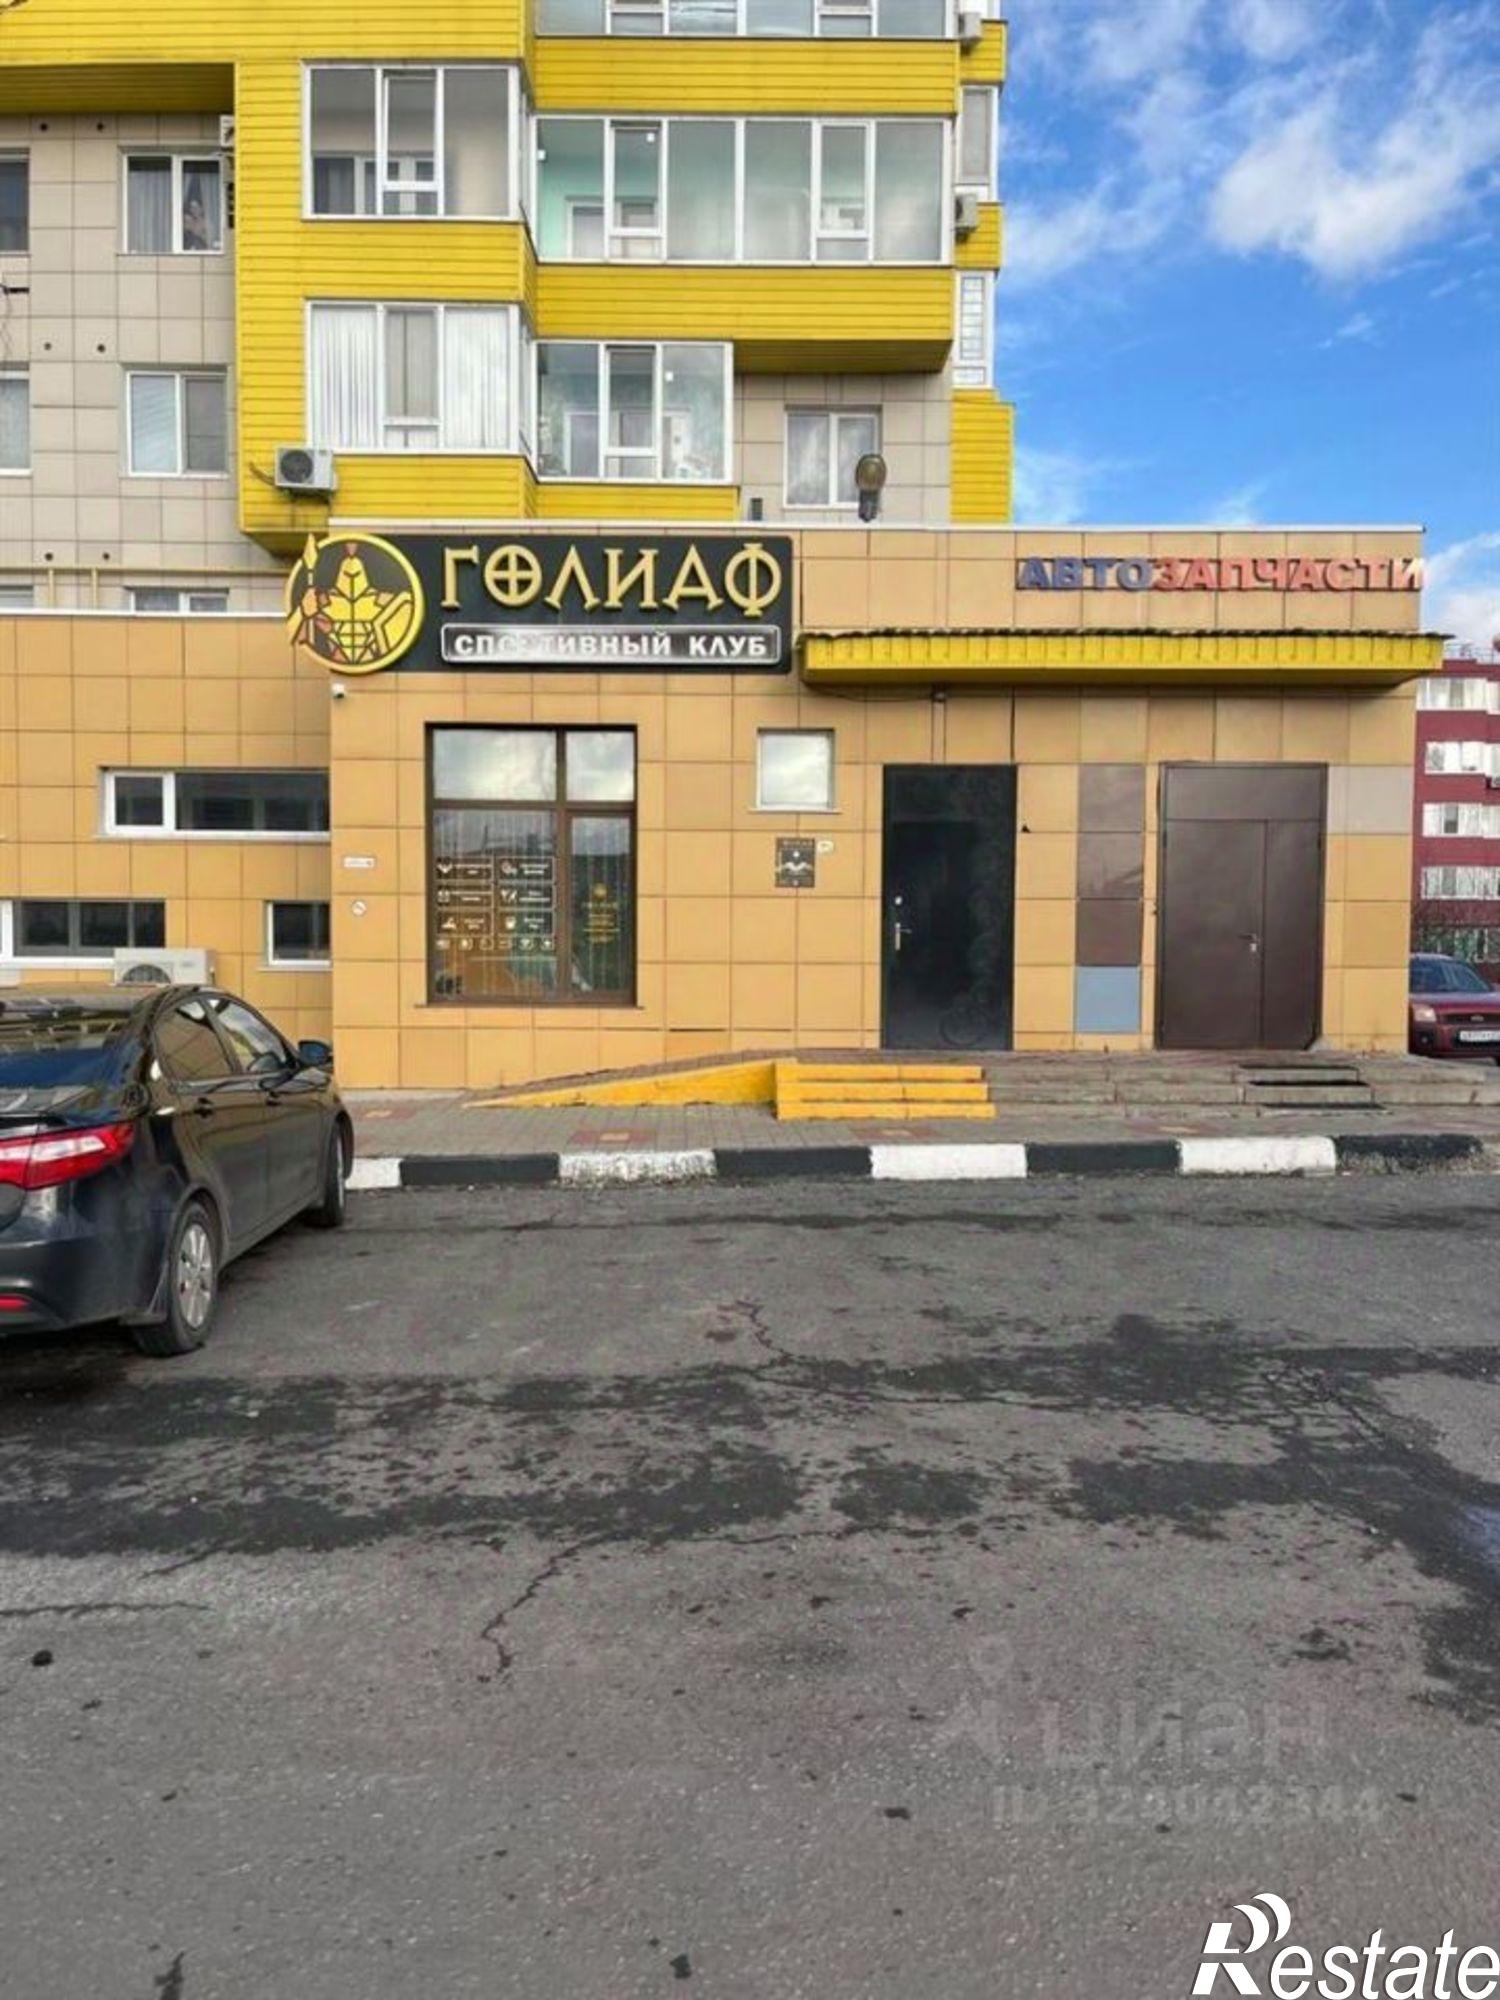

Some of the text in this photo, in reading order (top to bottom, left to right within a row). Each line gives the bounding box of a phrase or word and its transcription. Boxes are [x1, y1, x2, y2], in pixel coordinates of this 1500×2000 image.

[441, 542, 782, 616] ГОЛИАФ
[1017, 557, 1426, 590] АВТОЗАПЧАСТИ
[688, 634, 768, 657] КЛУБ
